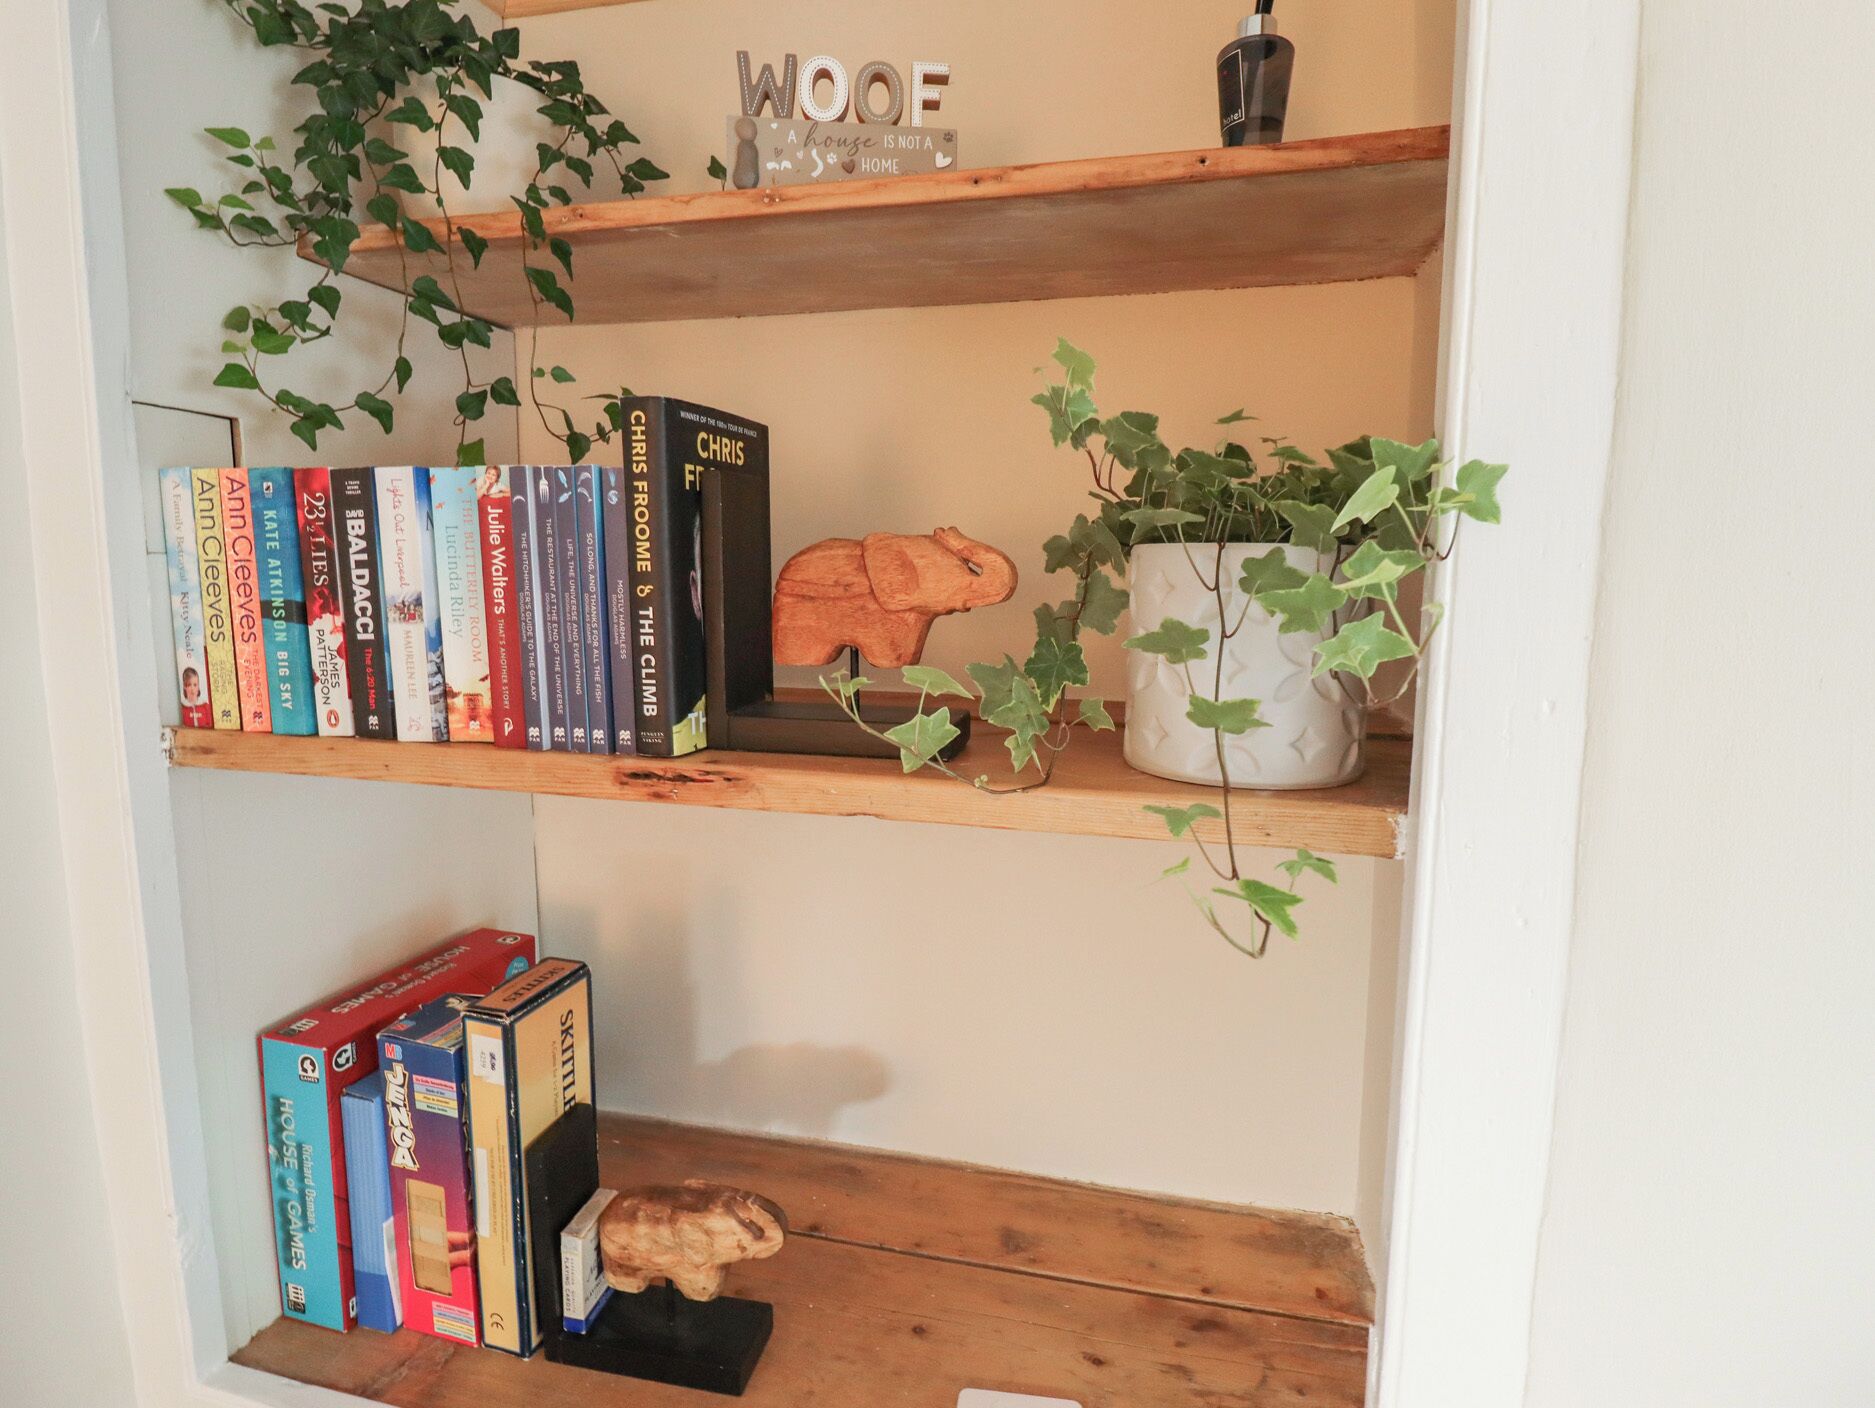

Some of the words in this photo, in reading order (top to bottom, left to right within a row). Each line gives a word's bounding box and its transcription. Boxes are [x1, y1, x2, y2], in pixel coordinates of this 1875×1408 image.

[736, 50, 950, 127] WOOF
[788, 130, 797, 144] A
[804, 121, 878, 157] house
[884, 135, 893, 149] IS
[899, 136, 920, 149] NOT
[924, 137, 932, 150] A
[862, 158, 899, 174] HOME
[630, 410, 647, 473] CHRIS
[680, 411, 700, 422] WINNER
[700, 415, 707, 423] OF
[707, 418, 715, 426] THE
[727, 424, 738, 432] TOUR
[744, 428, 757, 438] FRANCE
[697, 431, 744, 466] CHRIS
[174, 494, 183, 532] Family
[197, 477, 219, 530] Ann
[226, 476, 248, 529] Ann
[346, 509, 364, 518] DAVID
[386, 478, 404, 511] Lights
[461, 497, 473, 523] THE
[264, 510, 279, 550] KATE
[394, 514, 405, 534] Out
[486, 505, 506, 545] Julie
[520, 532, 528, 548] THE
[586, 533, 593, 544] SO
[633, 480, 652, 573] FROOME
[176, 536, 187, 582] Betrayal
[309, 536, 329, 586] LIES
[394, 539, 409, 589] Liverpool
[444, 525, 464, 591] Lucinda
[464, 527, 479, 610] BUTTERFLY
[546, 537, 556, 592] RESTAURANT
[568, 561, 576, 577] THE
[202, 536, 227, 642] Cleeves
[232, 535, 258, 643] Cleeves
[346, 518, 375, 641] BALDACCI
[491, 546, 511, 614] Walters
[550, 593, 557, 604] AT
[617, 580, 625, 613] MOSTLY
[180, 591, 192, 622] Kitty
[267, 558, 288, 642] ATKINSON
[449, 596, 467, 638] Riley
[569, 579, 578, 621] UNIVERSE
[589, 594, 598, 629] THANKS
[184, 625, 194, 660] Neale
[469, 616, 482, 662] ROOM
[497, 618, 505, 646] THAT'S
[525, 610, 534, 638] GUIDE
[527, 639, 535, 649] TO
[552, 623, 560, 641] END
[571, 623, 579, 641] AND
[618, 614, 627, 660] HARMLESS
[638, 606, 655, 647] THE
[276, 651, 290, 676] BIG
[316, 629, 331, 705] PATTERSON
[328, 646, 340, 689] JAMES
[402, 630, 414, 681] MAUREEN
[408, 683, 418, 700] LEE
[499, 647, 508, 684] ANOTHER
[554, 643, 561, 655] OF
[572, 643, 583, 695] EVERYTHING
[243, 659, 253, 698] EVENING
[254, 668, 263, 709] DARKEST
[280, 683, 293, 710] SKY
[364, 648, 372, 665] The
[368, 690, 376, 710] Man
[502, 685, 511, 709] STORY
[529, 670, 538, 701] GALAXY
[555, 674, 564, 715] UNIVERSE
[595, 684, 603, 702] FISH
[640, 654, 657, 718] CLIMB
[688, 711, 706, 736] TH
[414, 945, 470, 973] HOUSE
[331, 981, 397, 1014] GAMES
[503, 967, 565, 1003] SKITTLES
[384, 1042, 402, 1060] MB
[559, 1008, 577, 1113] SKITTLE
[279, 1098, 298, 1169] HOUSE
[385, 1062, 420, 1171] JENGA
[301, 1144, 316, 1185] Richard
[286, 1178, 298, 1193] of
[304, 1189, 318, 1233] Osman's
[287, 1200, 306, 1271] GAMES
